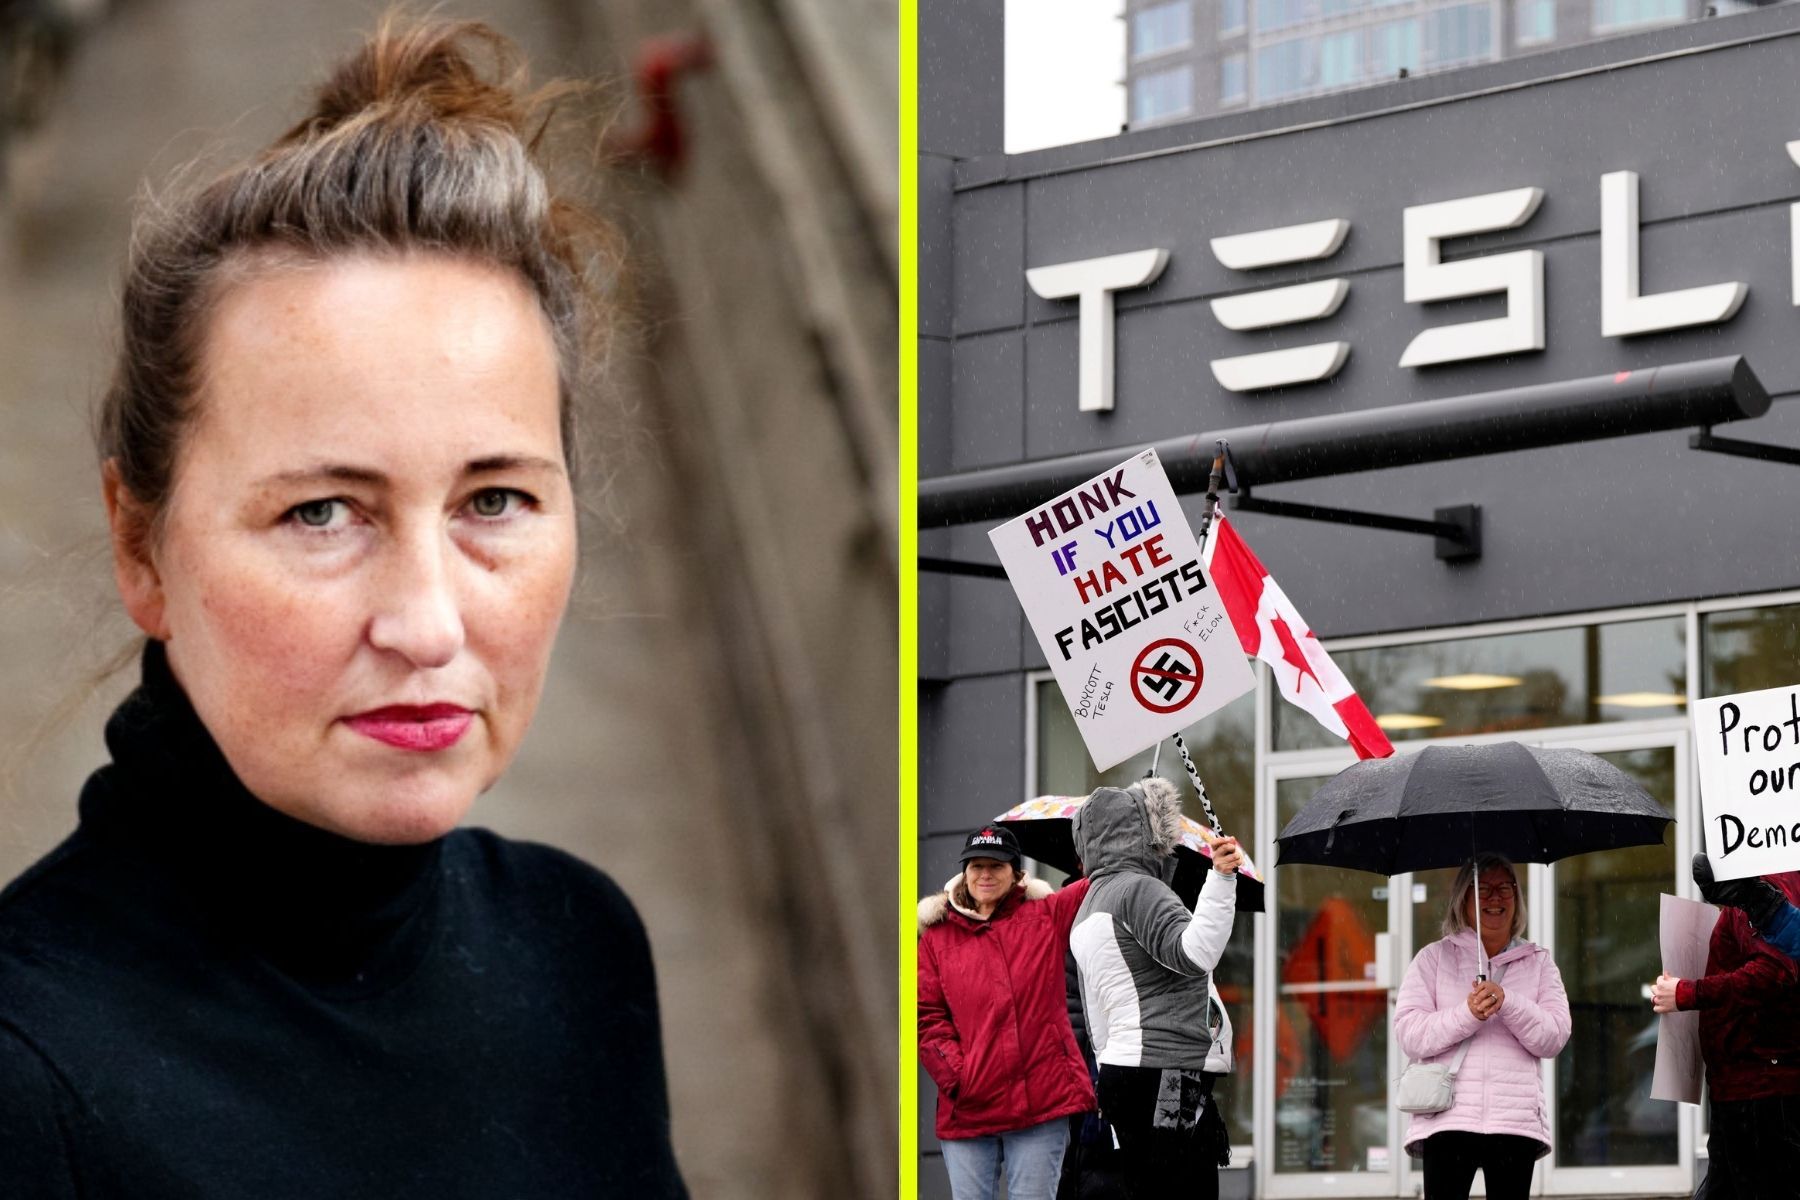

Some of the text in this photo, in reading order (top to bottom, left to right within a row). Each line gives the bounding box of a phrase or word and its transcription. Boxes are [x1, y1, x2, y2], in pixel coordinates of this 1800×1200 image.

[1026, 140, 1800, 411] TESL
[1025, 469, 1136, 547] HONK
[1051, 500, 1161, 576] IF YOU
[1073, 534, 1172, 604] HATE
[1055, 559, 1207, 661] FASCISTS
[1199, 614, 1223, 642] ELON
[1075, 662, 1102, 718] BOYCOTT
[1093, 682, 1115, 719] TESLA
[1719, 693, 1800, 755] Prot
[1749, 762, 1800, 795] our
